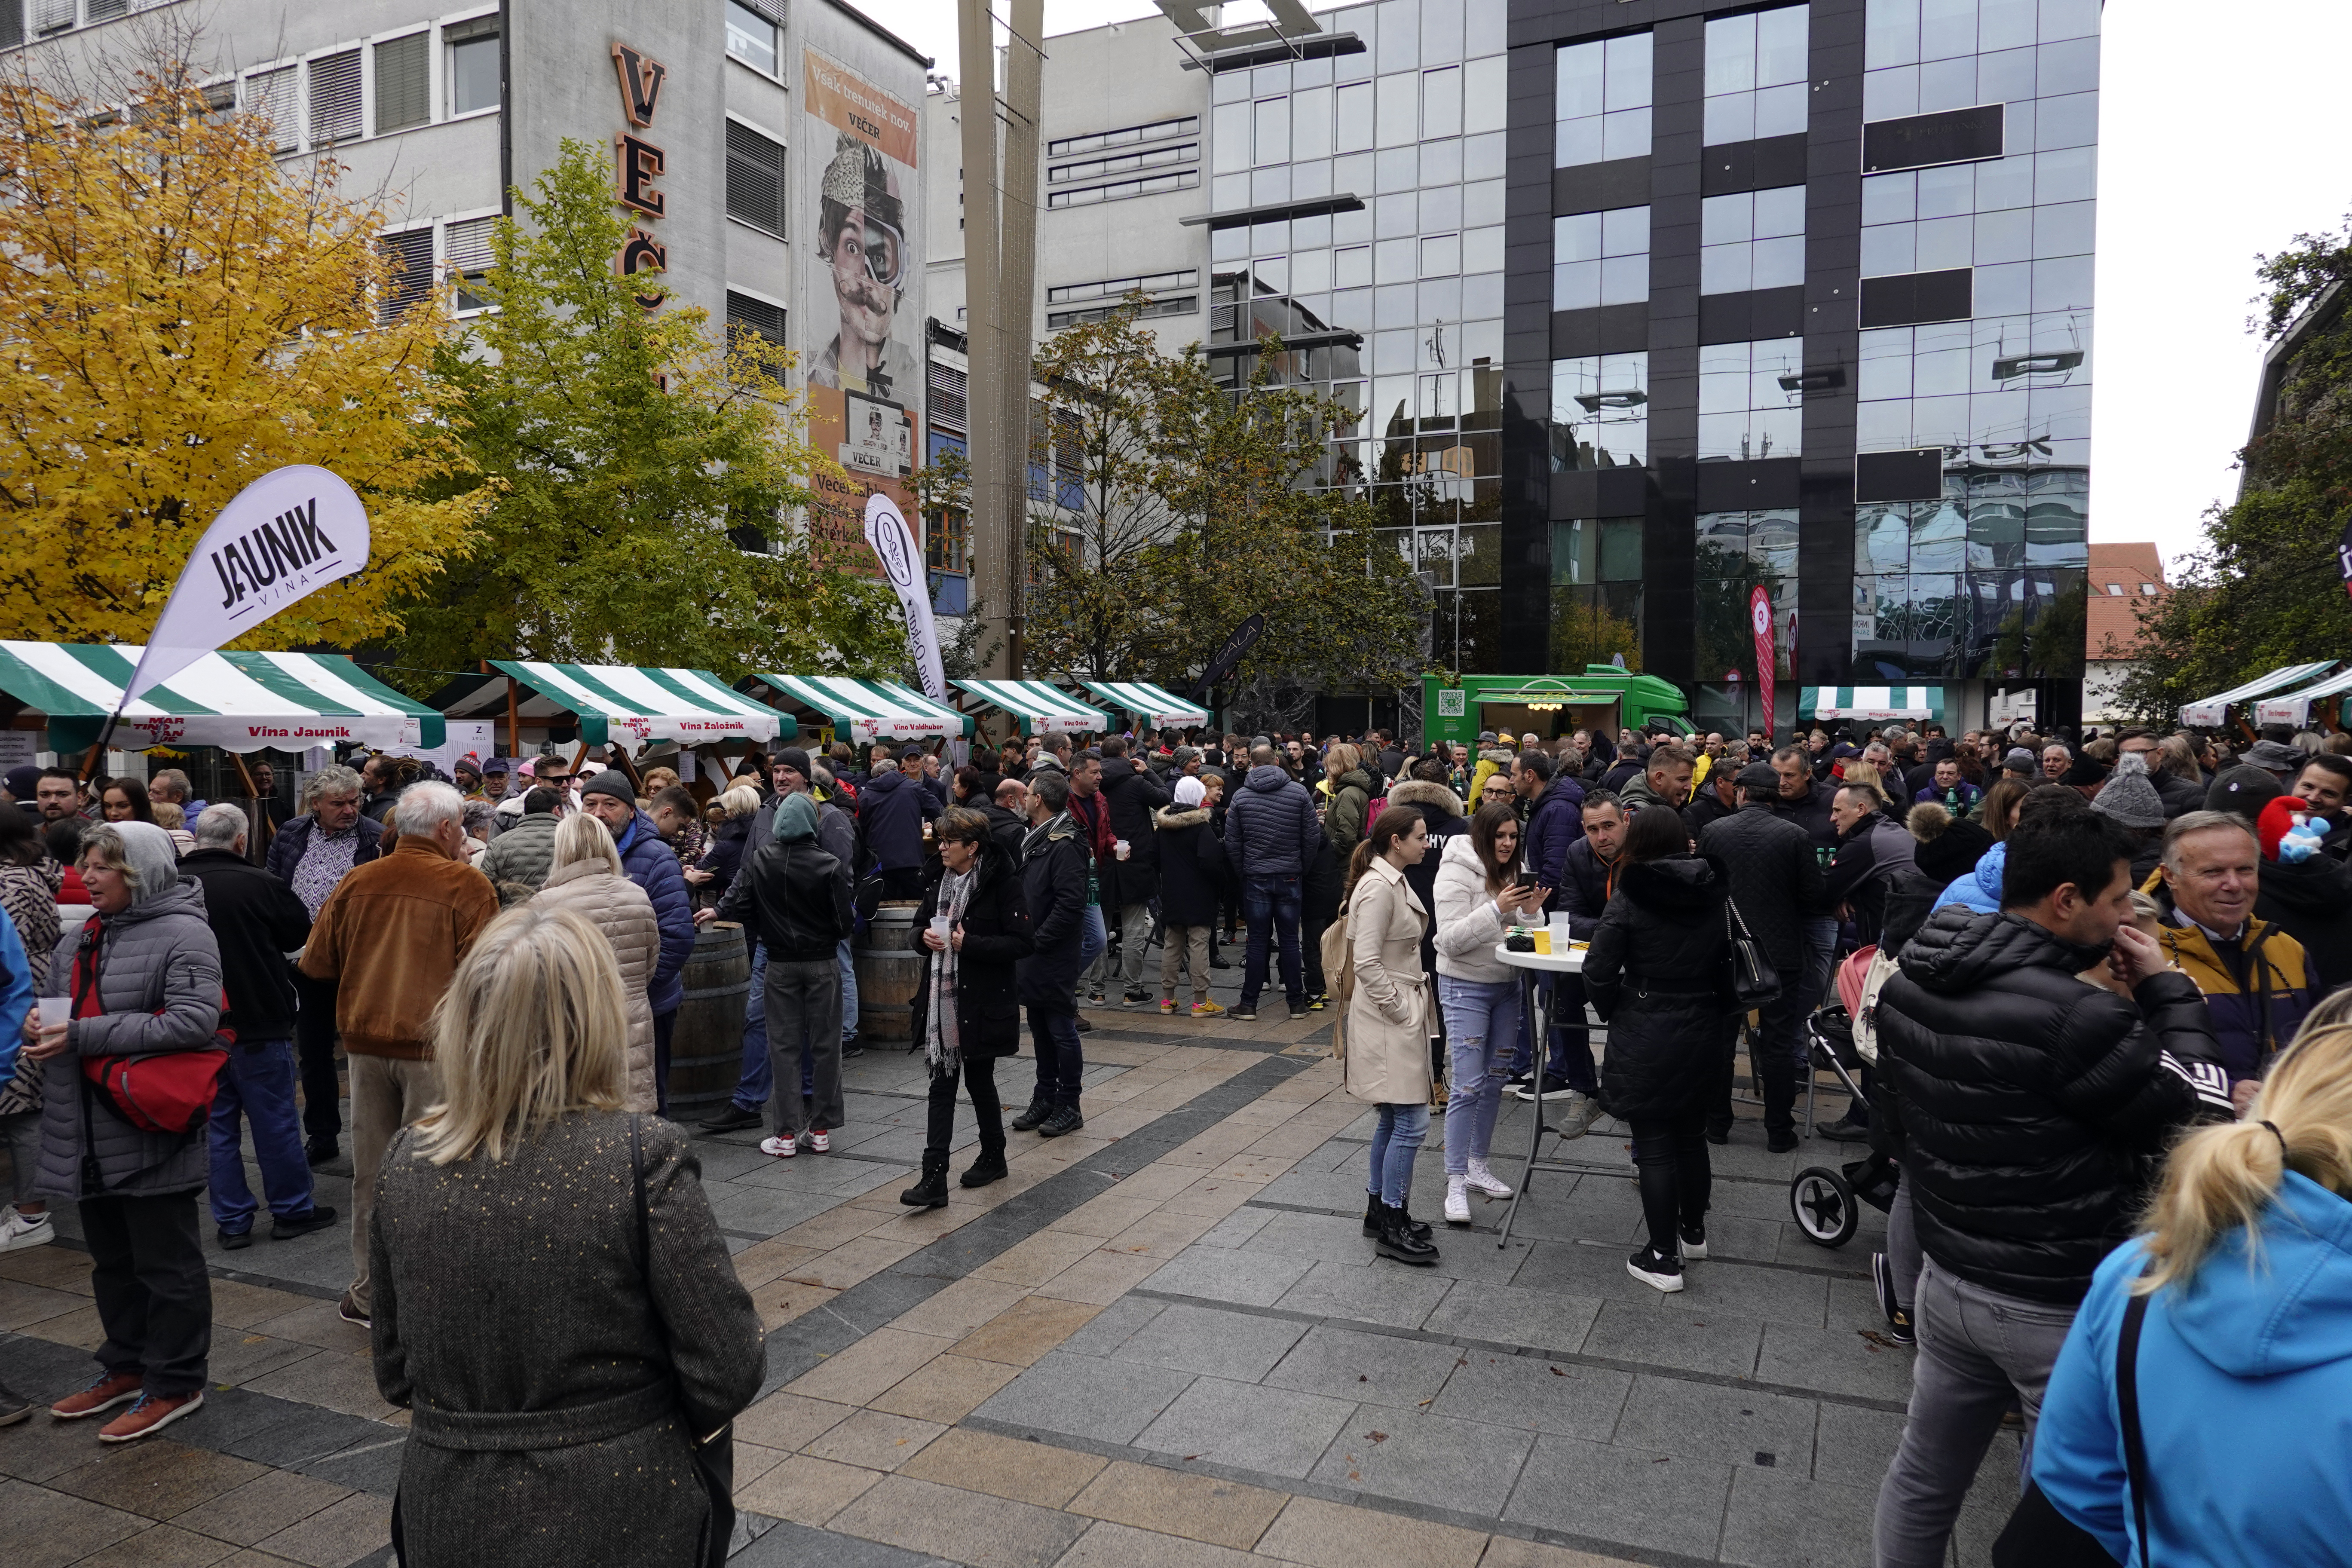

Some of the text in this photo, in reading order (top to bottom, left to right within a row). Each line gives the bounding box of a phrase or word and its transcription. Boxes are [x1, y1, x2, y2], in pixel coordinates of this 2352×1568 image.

[812, 65, 911, 133] Vsak trenutek nov.
[848, 111, 880, 140] VEČER
[852, 451, 881, 468] VEČER
[211, 497, 338, 609] JAUNIK
[259, 574, 309, 605] VINA
[1216, 625, 1256, 665] GALA
[248, 726, 351, 737] Vina Jaunik
[704, 722, 744, 730] Založnik
[1425, 834, 1447, 849] HY
